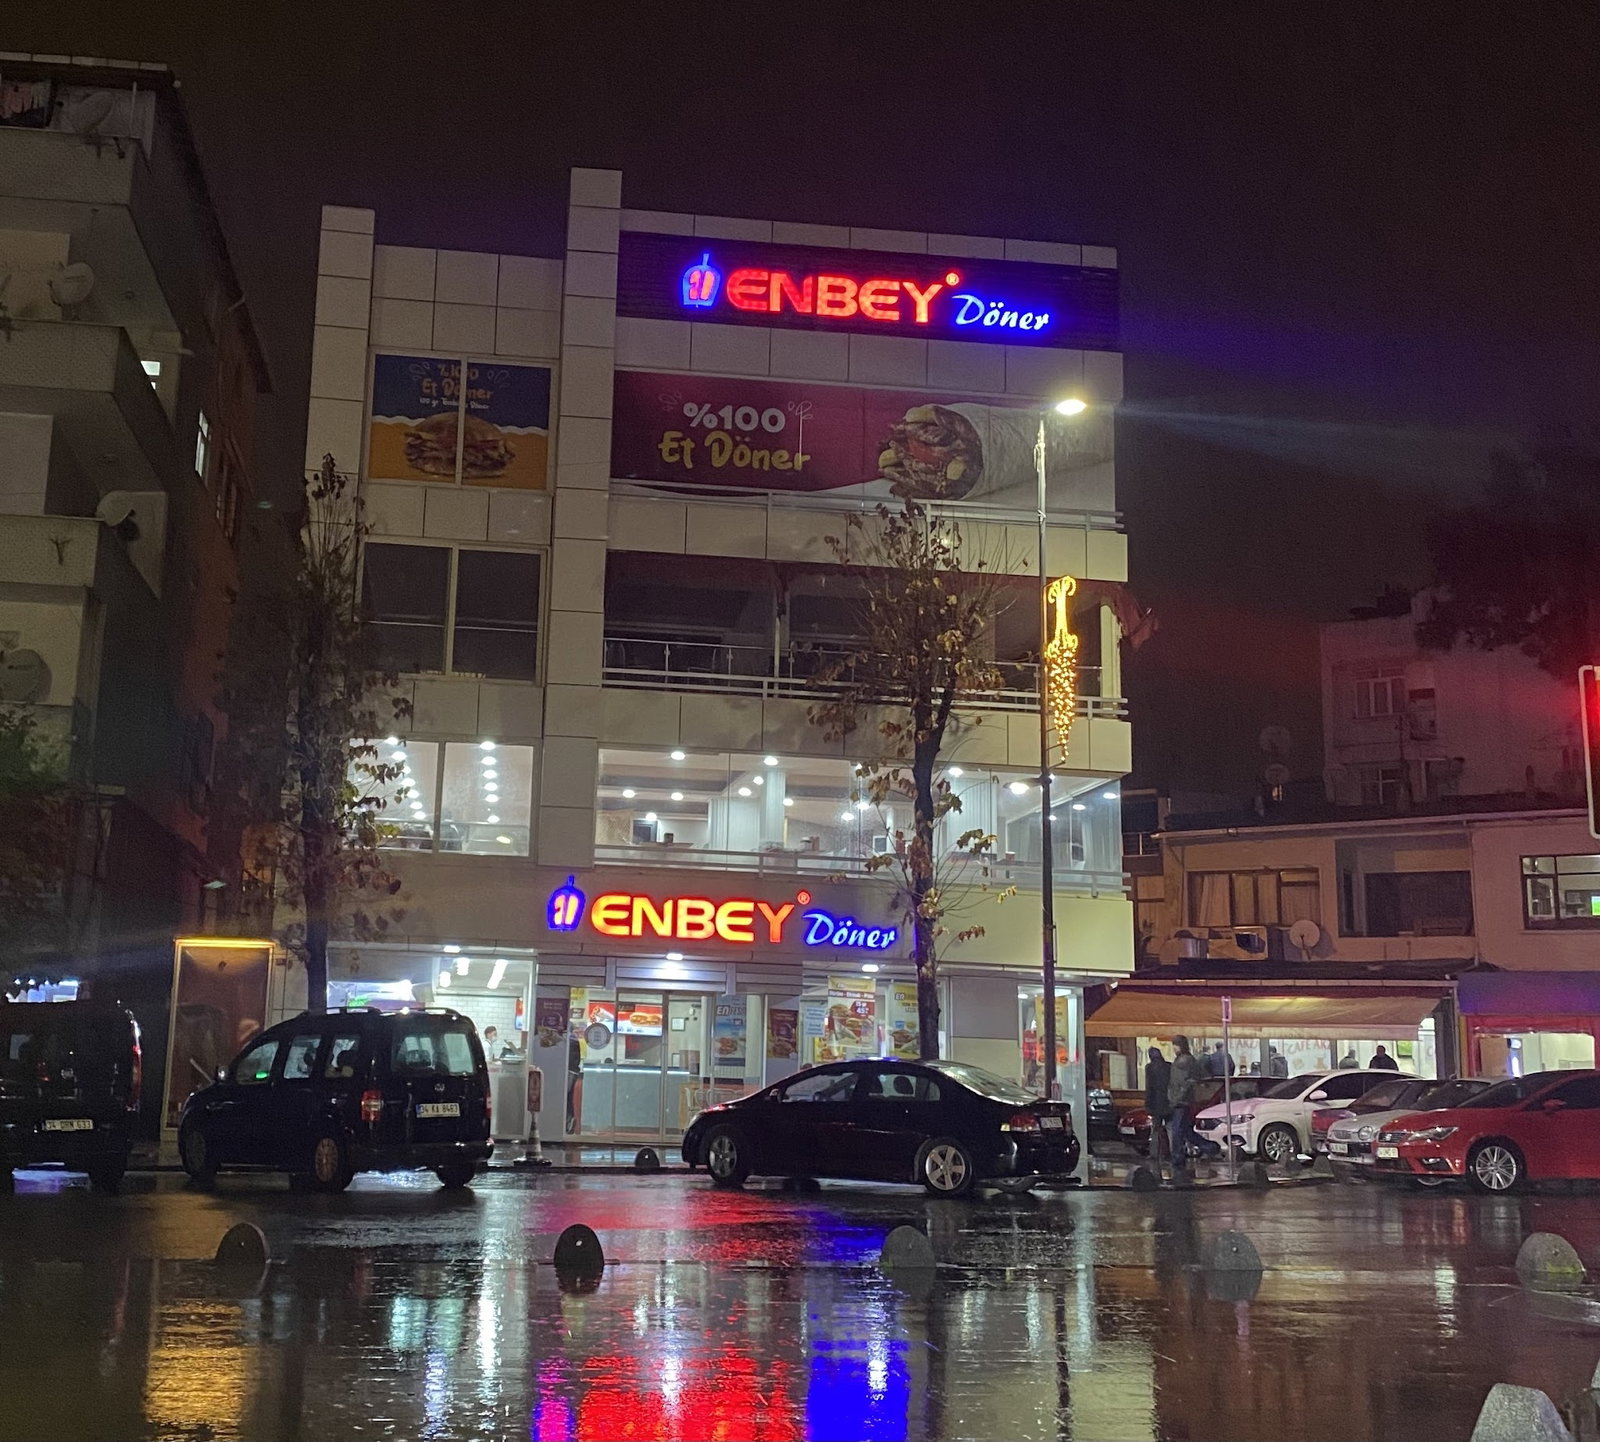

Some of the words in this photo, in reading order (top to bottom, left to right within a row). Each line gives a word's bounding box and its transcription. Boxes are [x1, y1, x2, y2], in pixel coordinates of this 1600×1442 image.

[726, 269, 943, 324] ENBEY
[951, 294, 1050, 332] Döner
[683, 402, 786, 433] %100
[658, 430, 695, 469] Et
[704, 430, 811, 471] Döner
[591, 893, 795, 943] ENBEY
[802, 911, 896, 949] Döner
